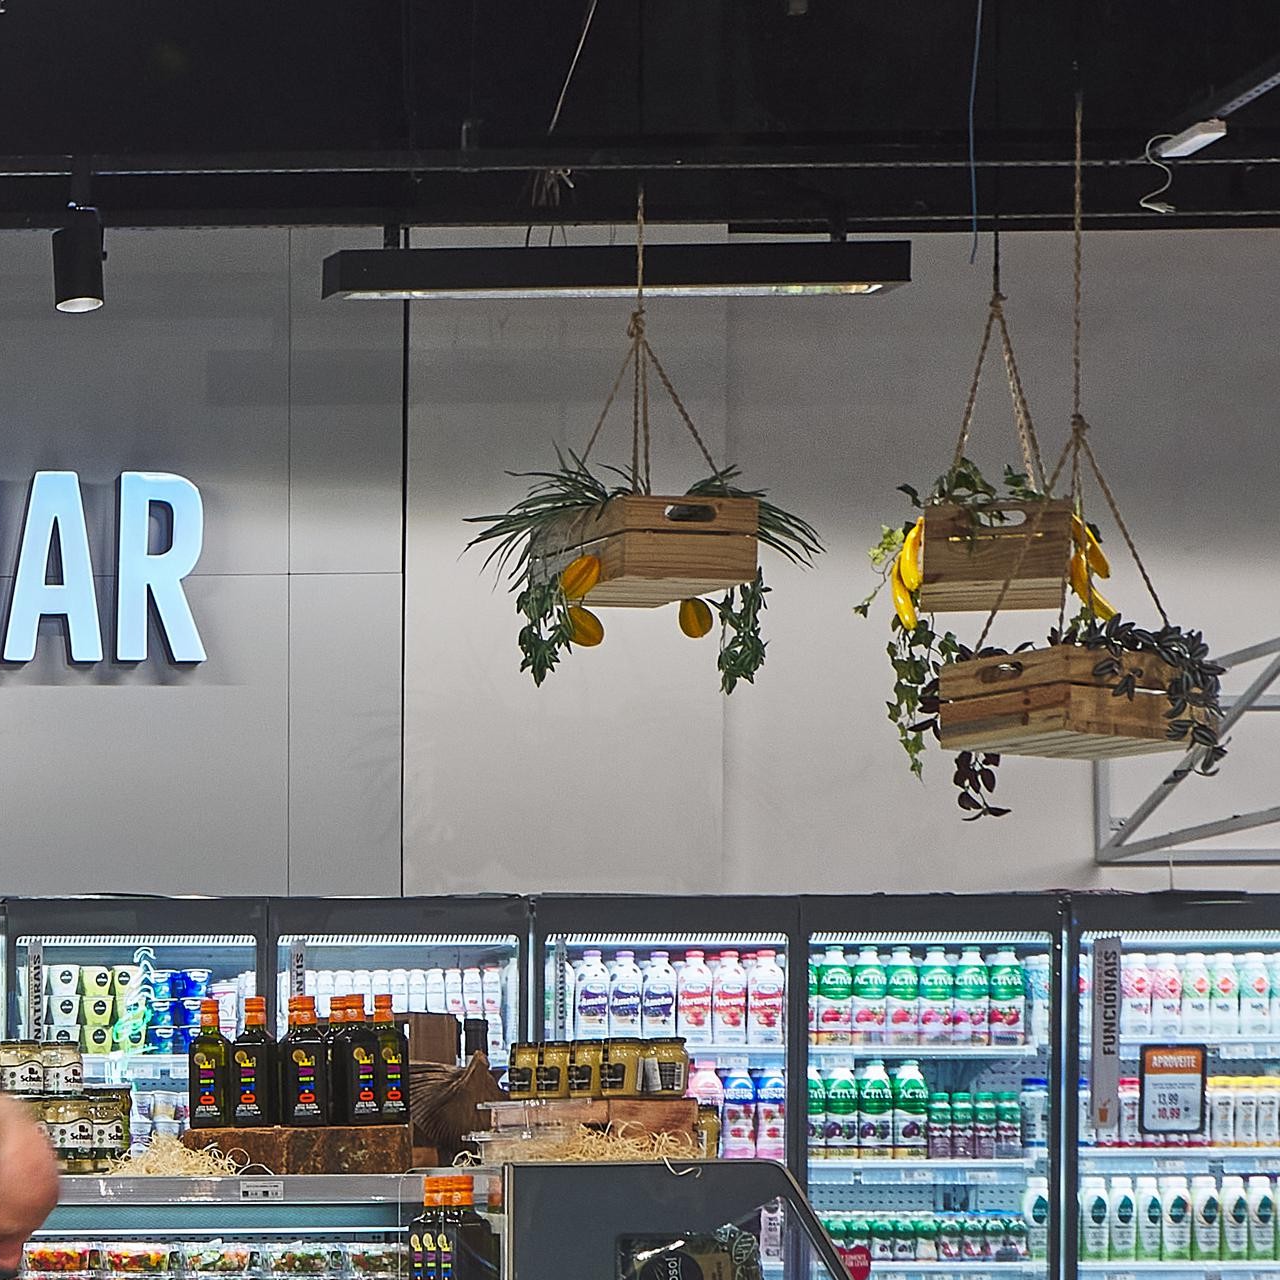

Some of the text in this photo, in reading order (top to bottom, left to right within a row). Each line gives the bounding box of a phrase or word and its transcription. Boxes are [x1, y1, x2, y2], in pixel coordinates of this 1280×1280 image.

[33, 953, 41, 1040] NATURAIS
[1103, 950, 1118, 1056] FUNCIONAIS
[1151, 1055, 1197, 1068] APROVEITE
